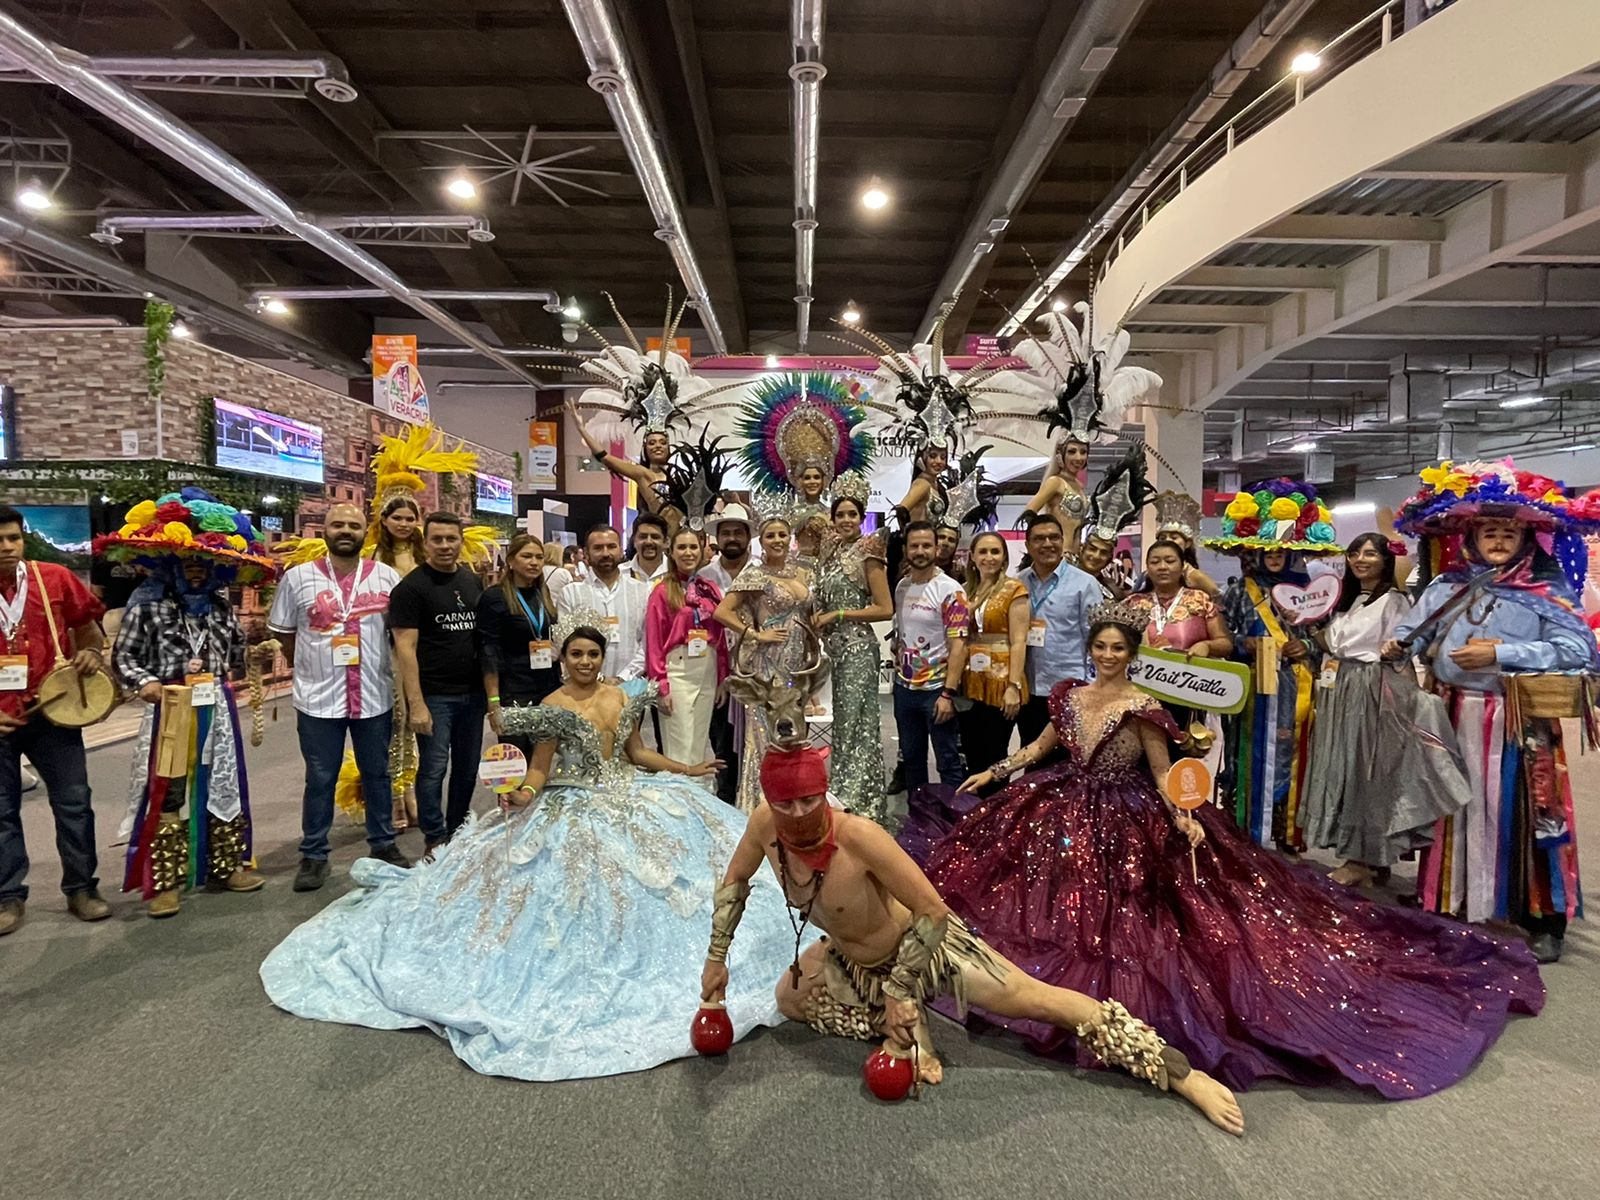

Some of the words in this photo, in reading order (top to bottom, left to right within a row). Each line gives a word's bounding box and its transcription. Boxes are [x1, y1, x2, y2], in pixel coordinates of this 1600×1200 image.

[1290, 589, 1329, 606] TUXTLA
[1144, 663, 1180, 685] Visit
[1176, 671, 1227, 697] Tuxtla
